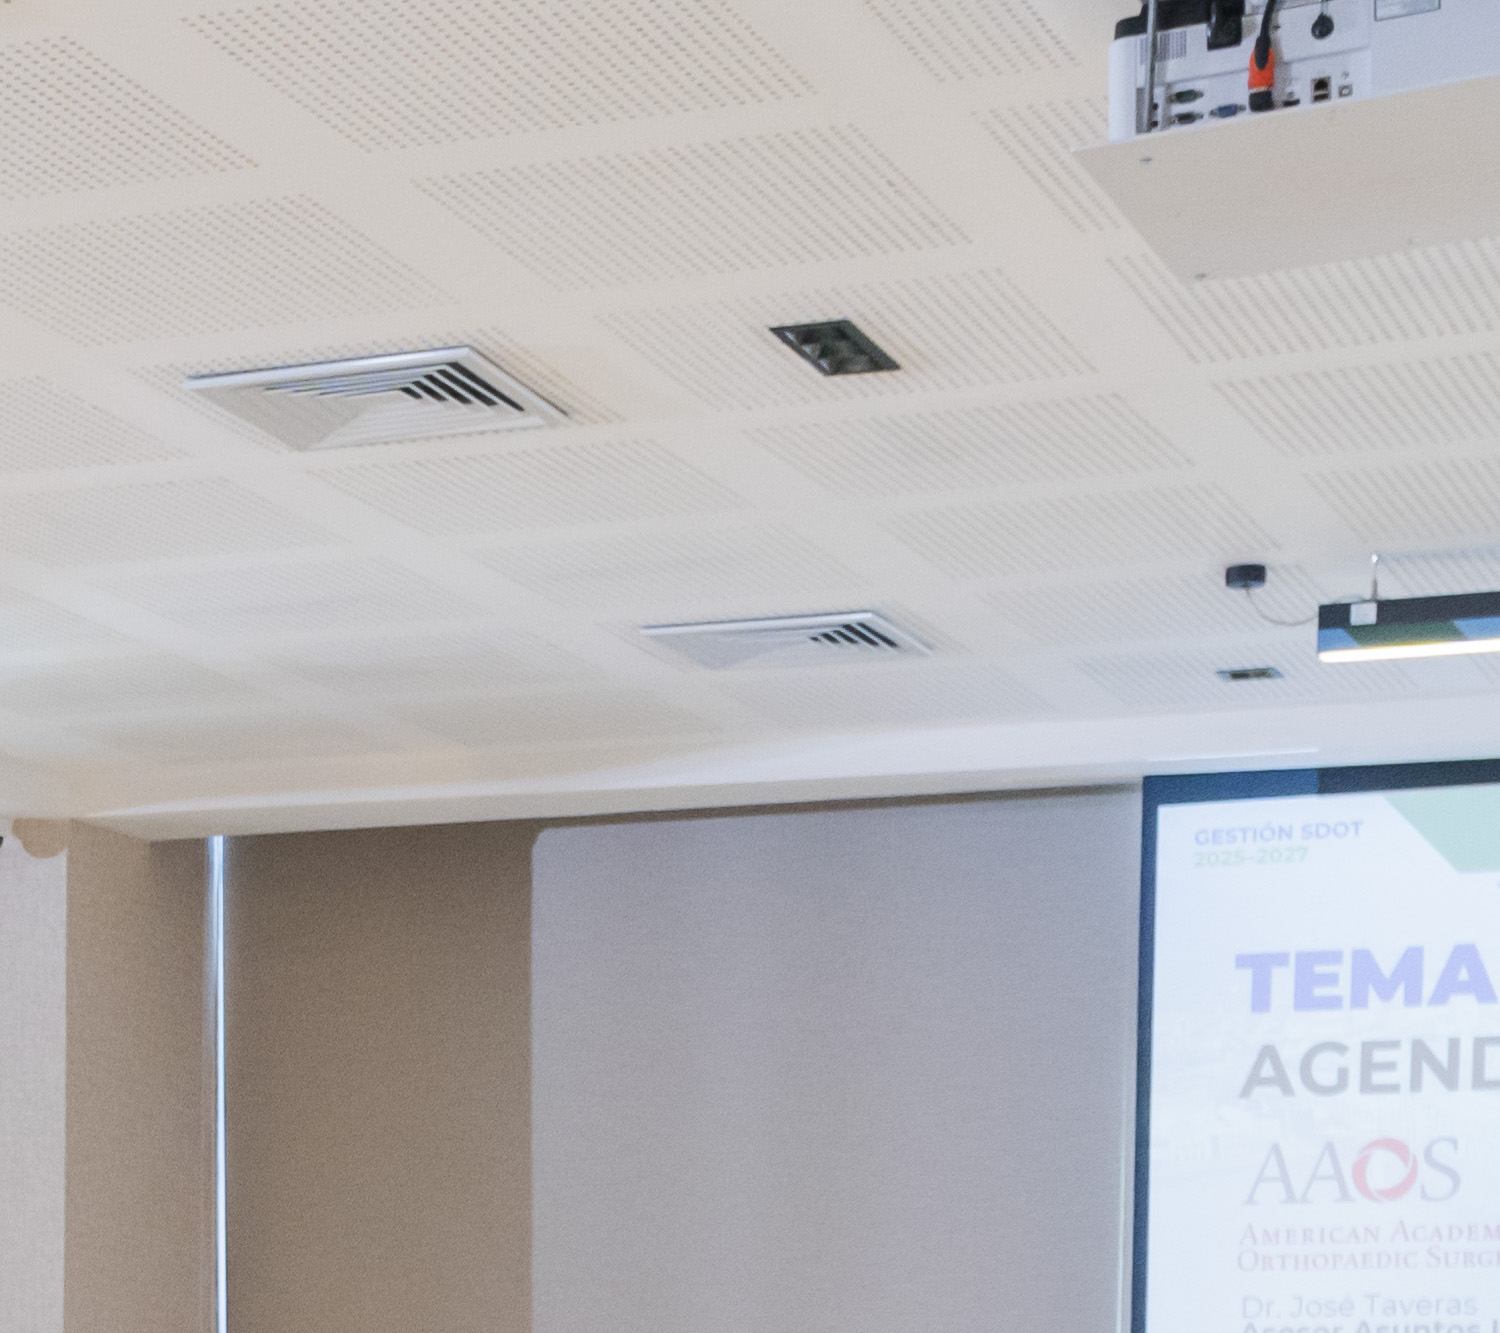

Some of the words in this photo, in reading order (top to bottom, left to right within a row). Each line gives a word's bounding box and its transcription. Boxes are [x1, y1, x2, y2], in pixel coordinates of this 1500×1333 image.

[1194, 820, 1294, 847] GESTIÓN
[1300, 820, 1364, 841] SDOT
[1194, 846, 1310, 868] 2025-2027
[1235, 943, 1499, 1014] TEMA
[1241, 1136, 1463, 1205] AAOS
[1239, 1222, 1381, 1247] AMERICAN
[1241, 1295, 1282, 1319] Dr.
[1289, 1293, 1355, 1319] José
[1363, 1293, 1479, 1317] Taveras
